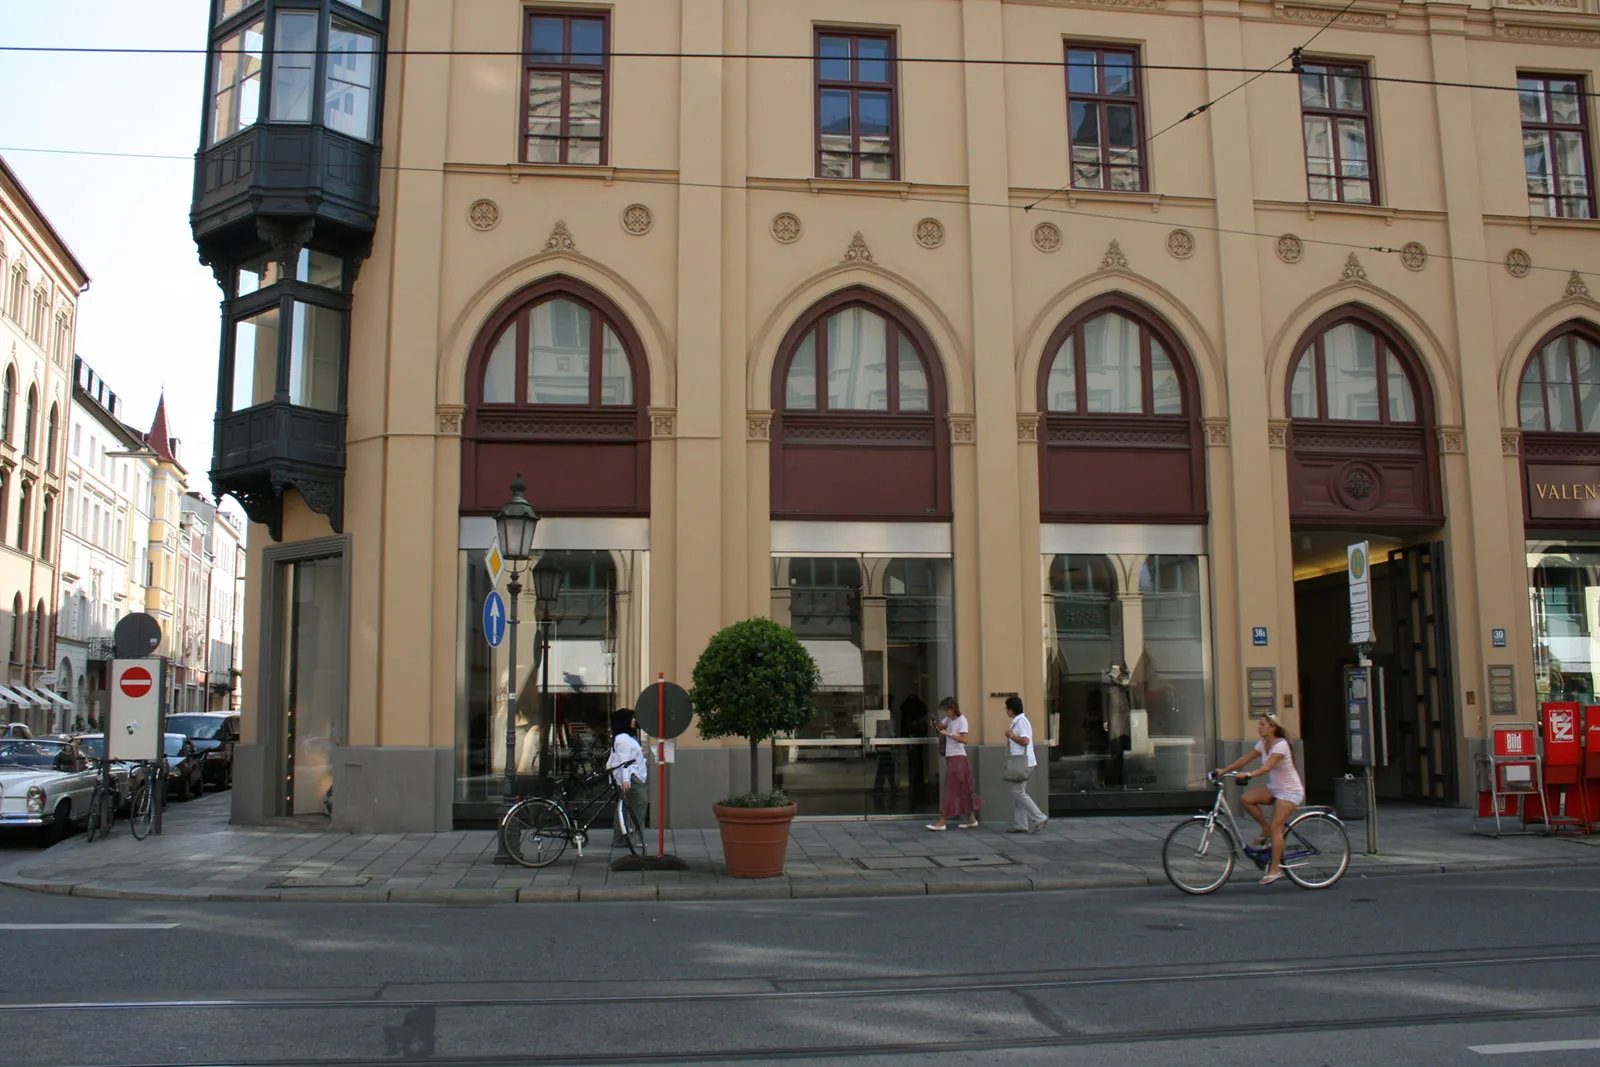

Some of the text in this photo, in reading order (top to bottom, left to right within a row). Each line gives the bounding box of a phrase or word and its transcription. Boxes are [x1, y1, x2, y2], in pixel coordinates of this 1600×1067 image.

[1494, 630, 1504, 639] 30
[1550, 712, 1573, 739] tz
[1506, 733, 1522, 750] Bild
